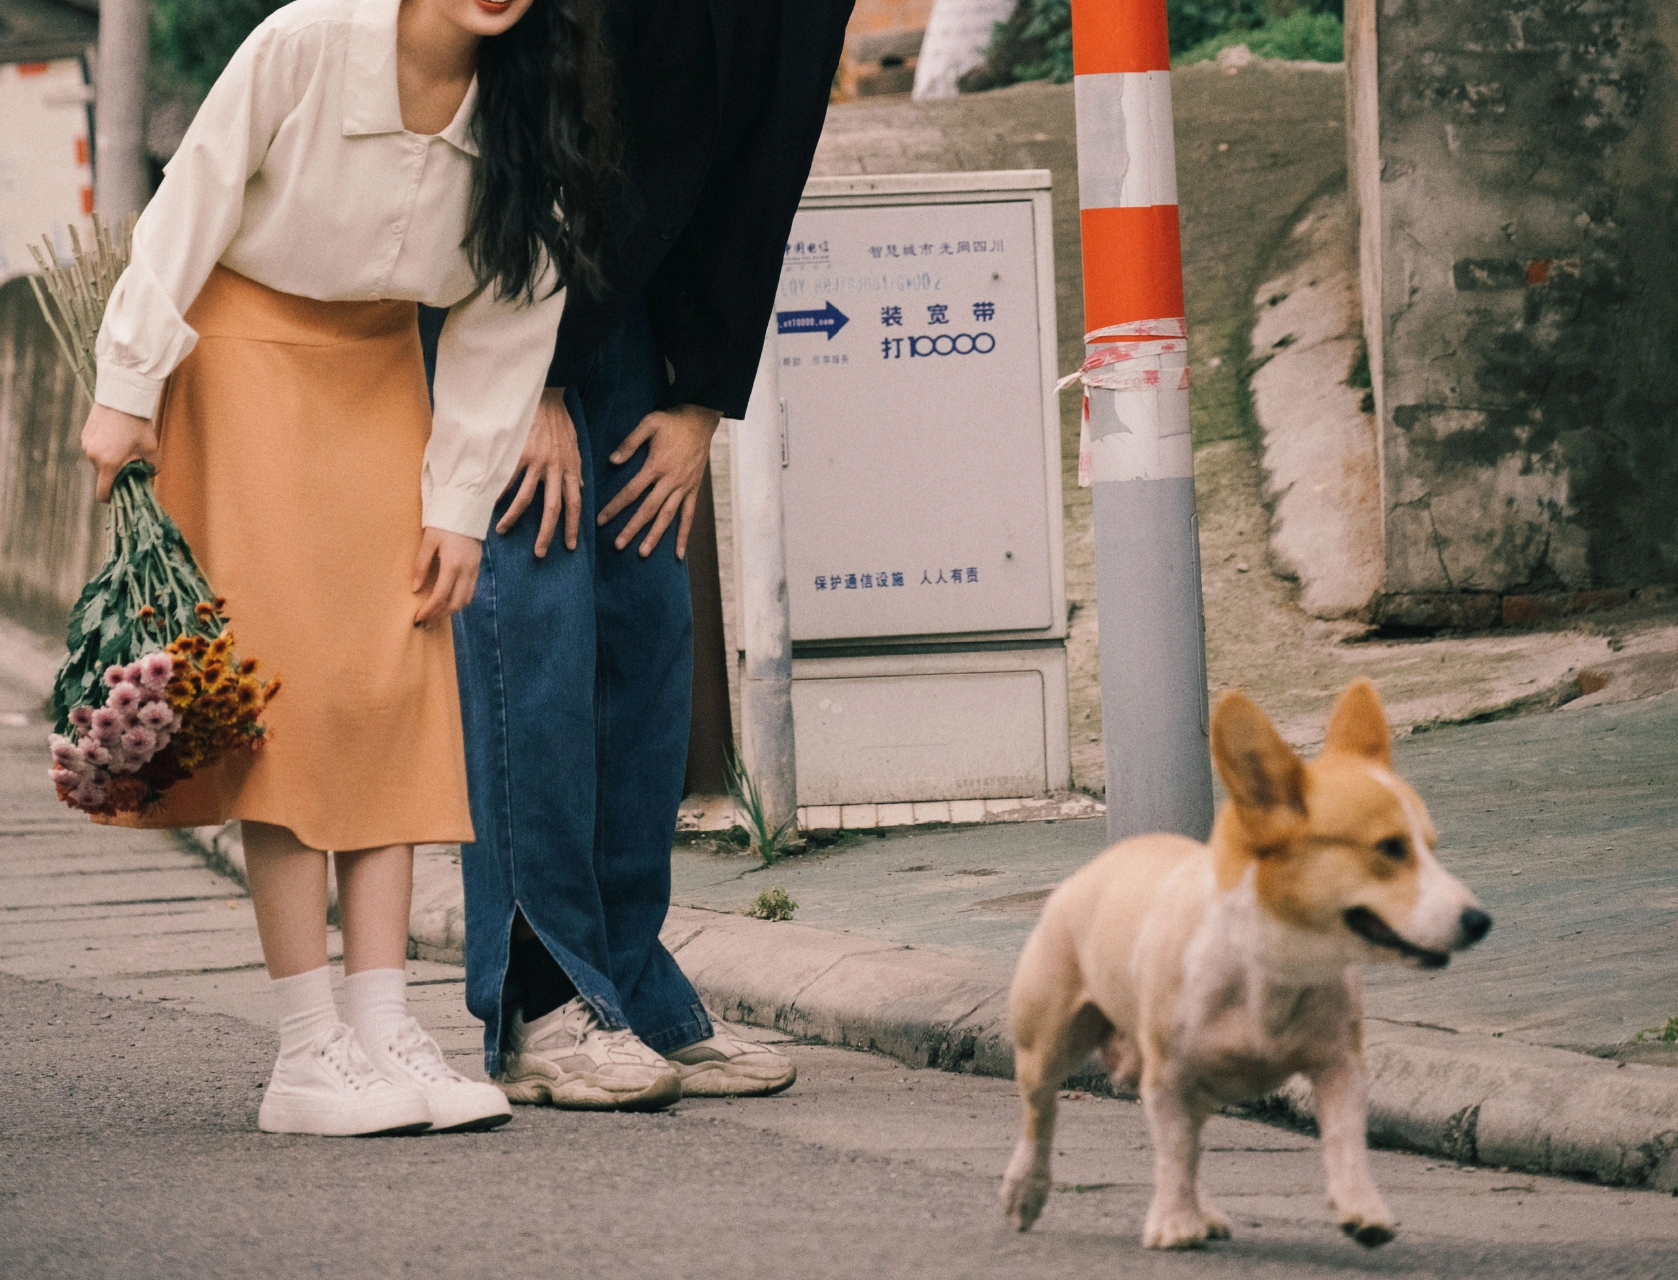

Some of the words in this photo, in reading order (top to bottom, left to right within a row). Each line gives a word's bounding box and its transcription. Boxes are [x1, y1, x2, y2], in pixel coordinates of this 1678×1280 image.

[881, 302, 995, 327] 装宽带
[881, 332, 996, 359] 打10000
[814, 572, 904, 591] 保护通信设施
[920, 567, 979, 585] 人人有责
